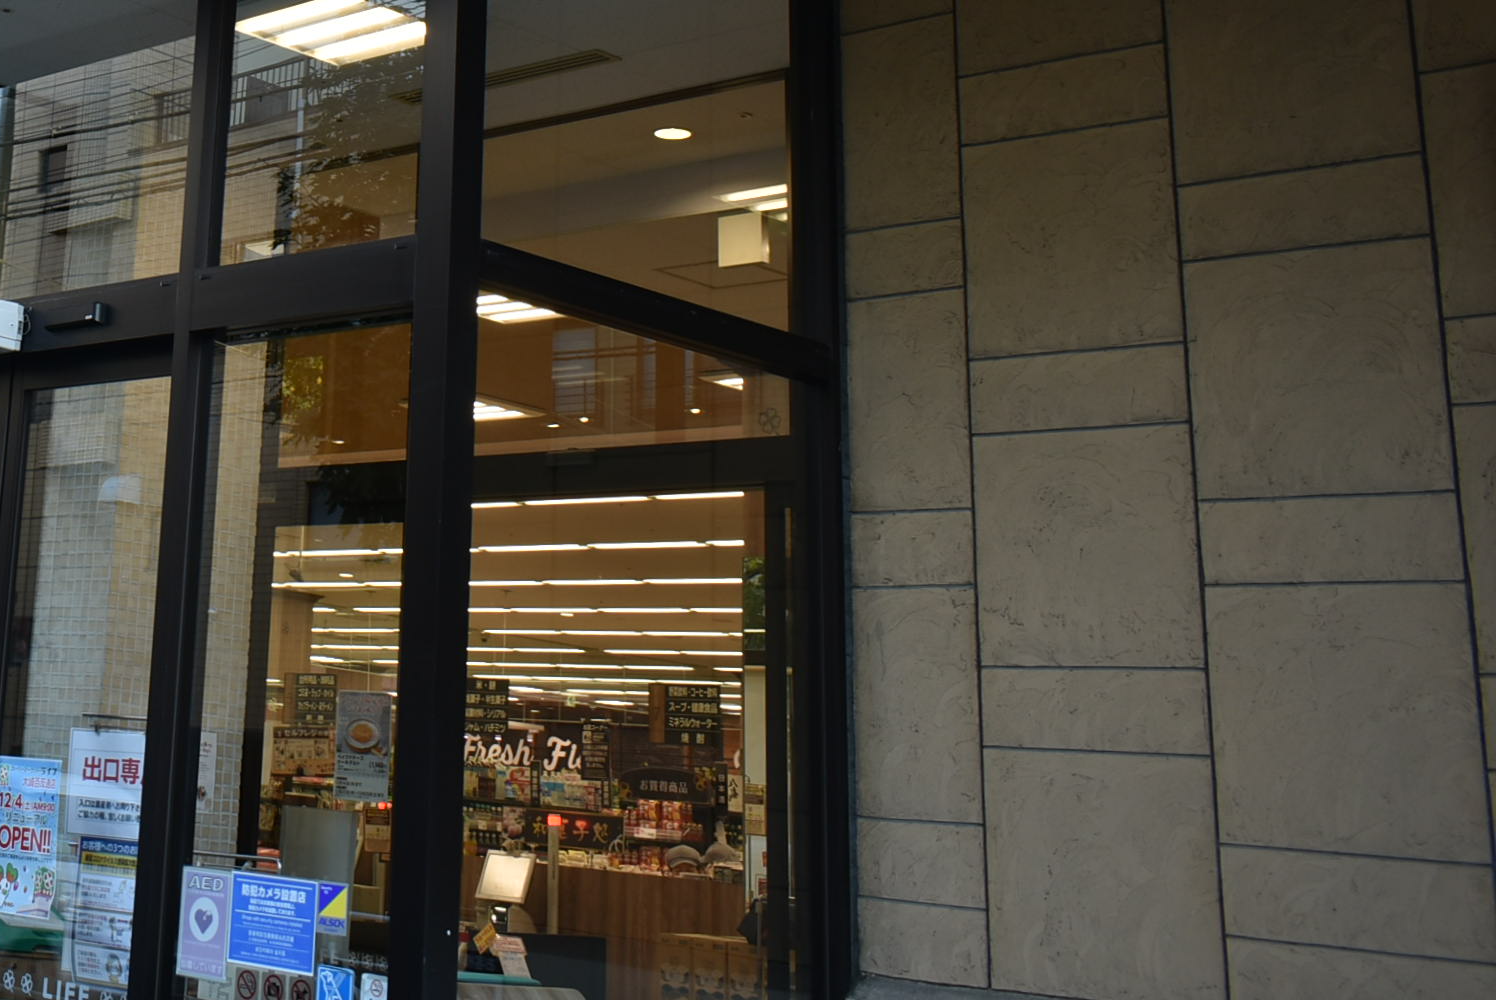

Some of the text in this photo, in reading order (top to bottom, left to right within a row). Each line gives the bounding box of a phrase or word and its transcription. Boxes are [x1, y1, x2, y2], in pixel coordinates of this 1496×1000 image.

[464, 735, 535, 766] Fresh
[82, 755, 145, 786] 出口専
[640, 779, 689, 794] お買得商品
[188, 875, 224, 893] AED
[241, 883, 307, 905] 防犯カメラ設置店
[319, 917, 345, 929] ALSOK
